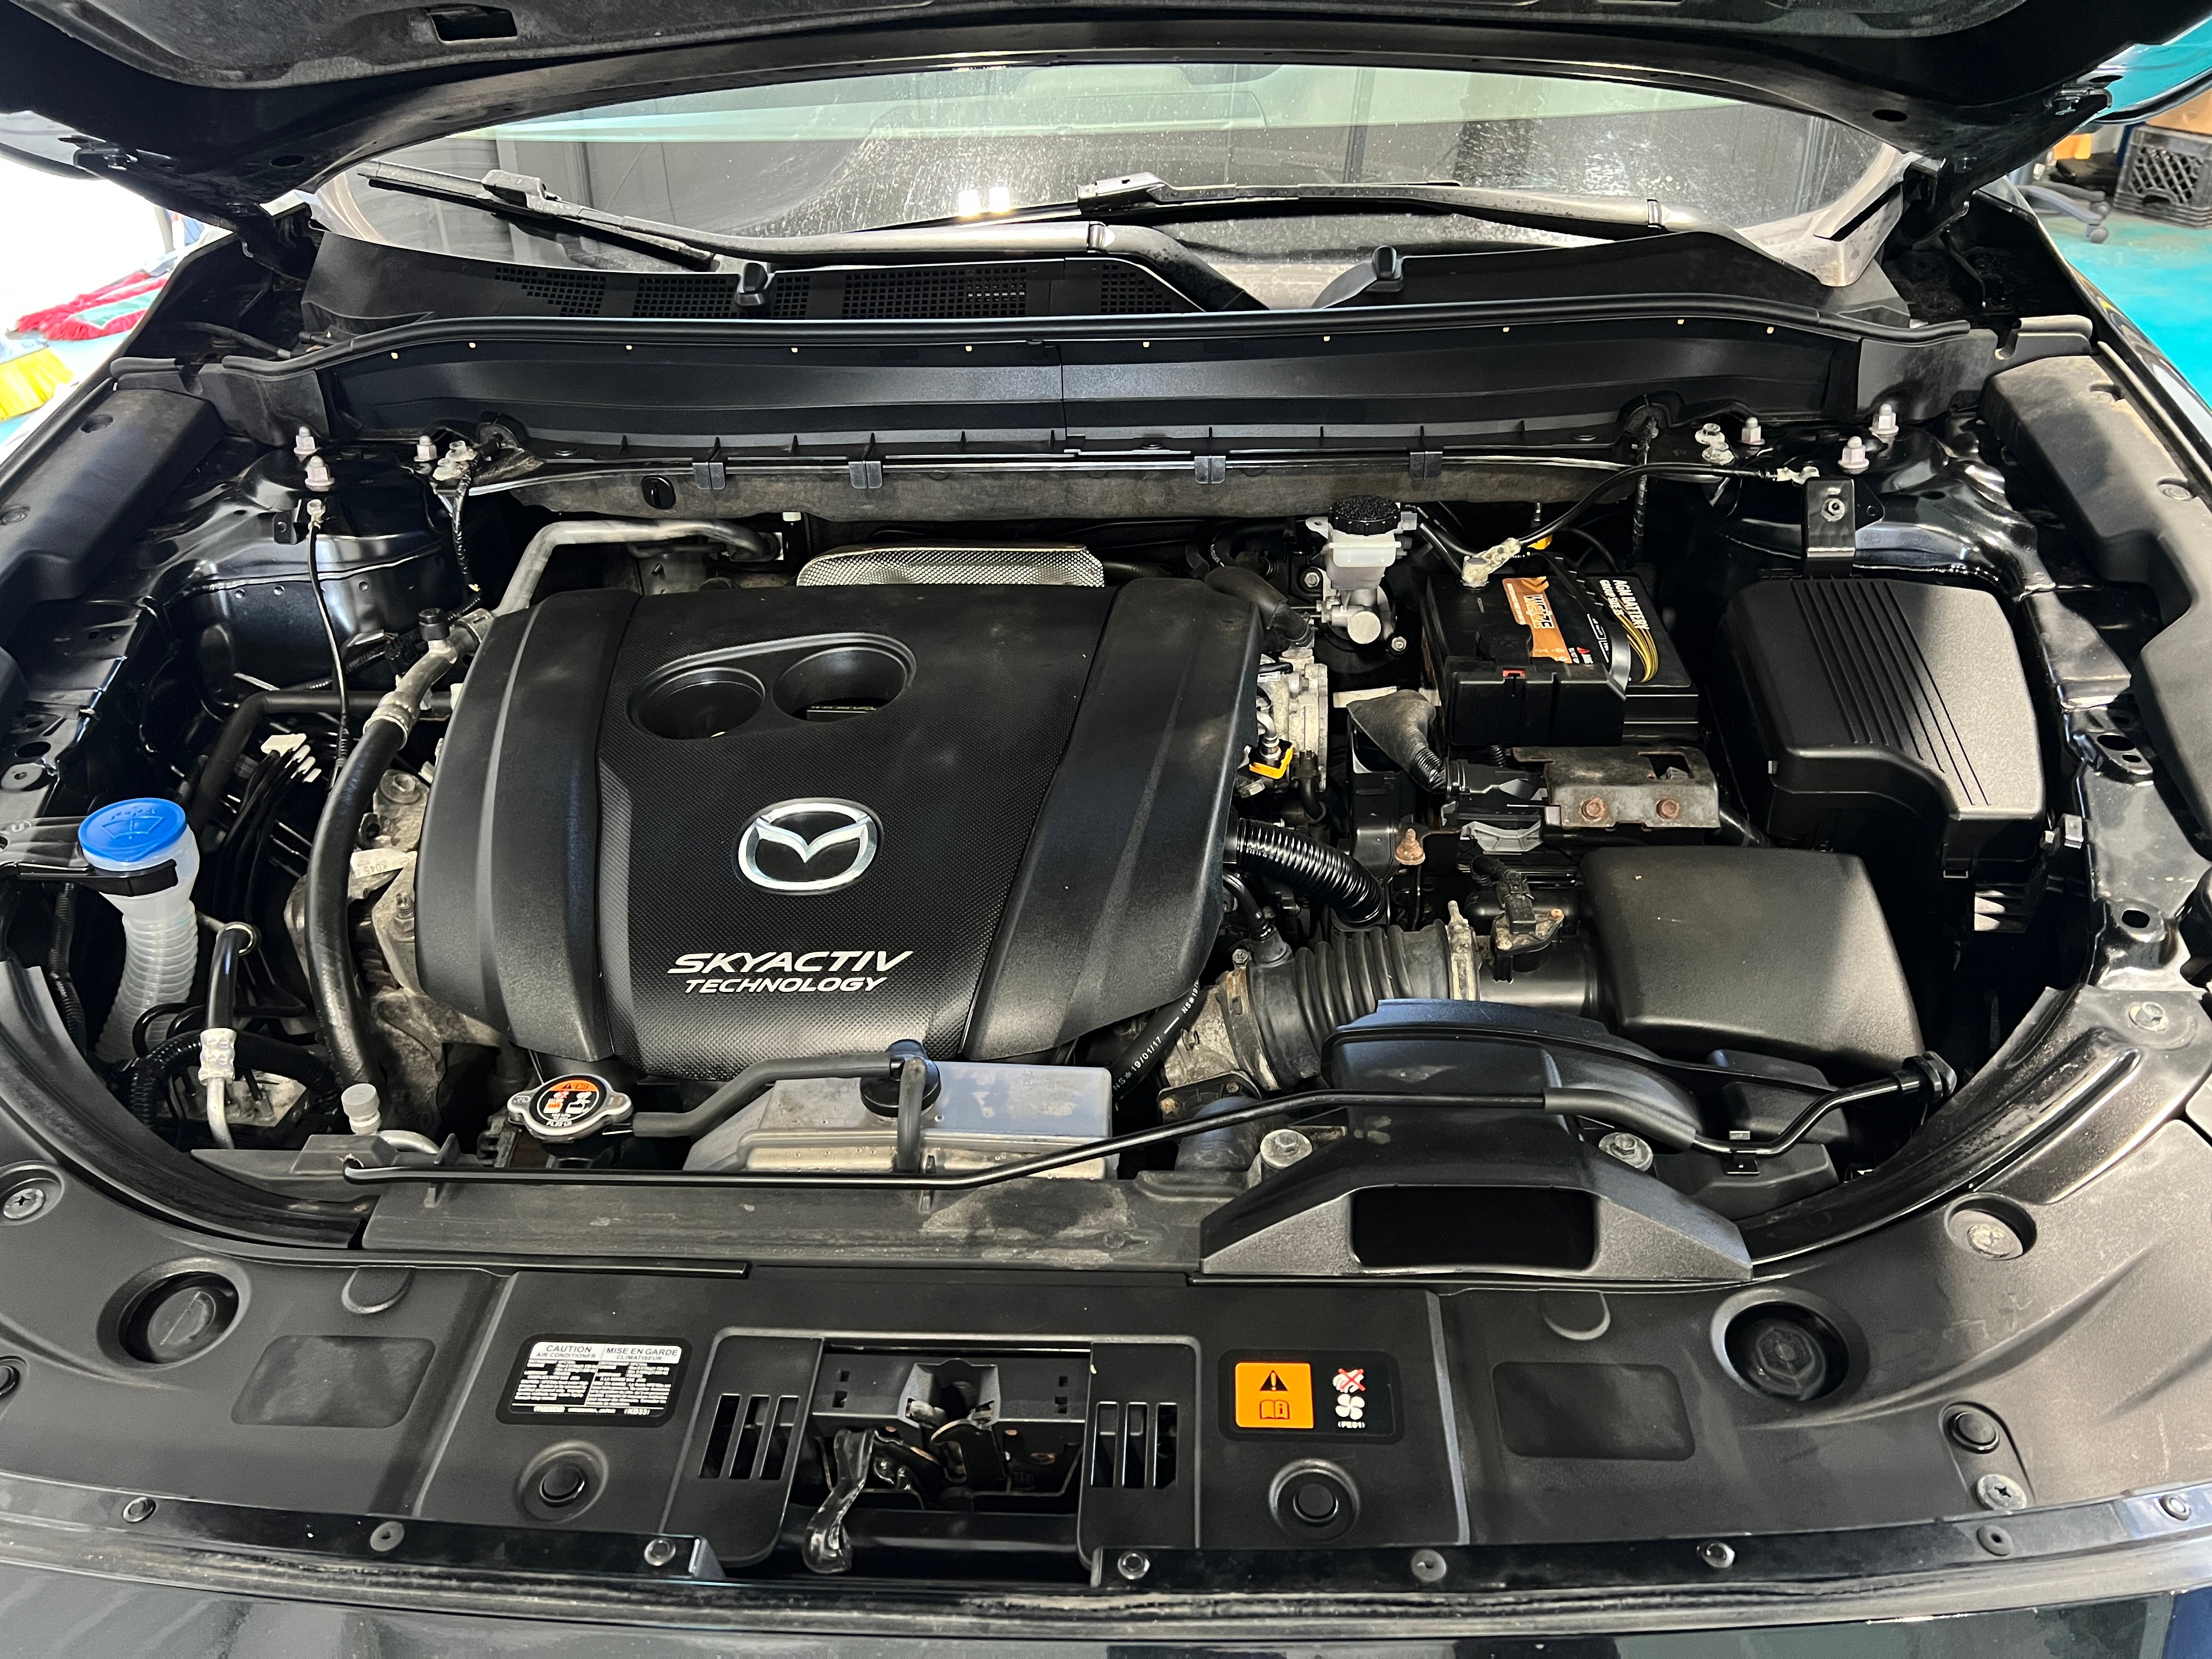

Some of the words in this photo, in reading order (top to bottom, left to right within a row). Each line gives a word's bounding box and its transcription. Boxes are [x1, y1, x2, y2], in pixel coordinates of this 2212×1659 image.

[1599, 579, 1616, 597] GROUP
[1607, 597, 1622, 610] SIZE
[1621, 596, 1650, 630] BATTERY
[667, 951, 913, 974] SKYACTIV
[685, 977, 888, 994] TECHNOLOGY
[546, 1345, 592, 1353] CAUTION
